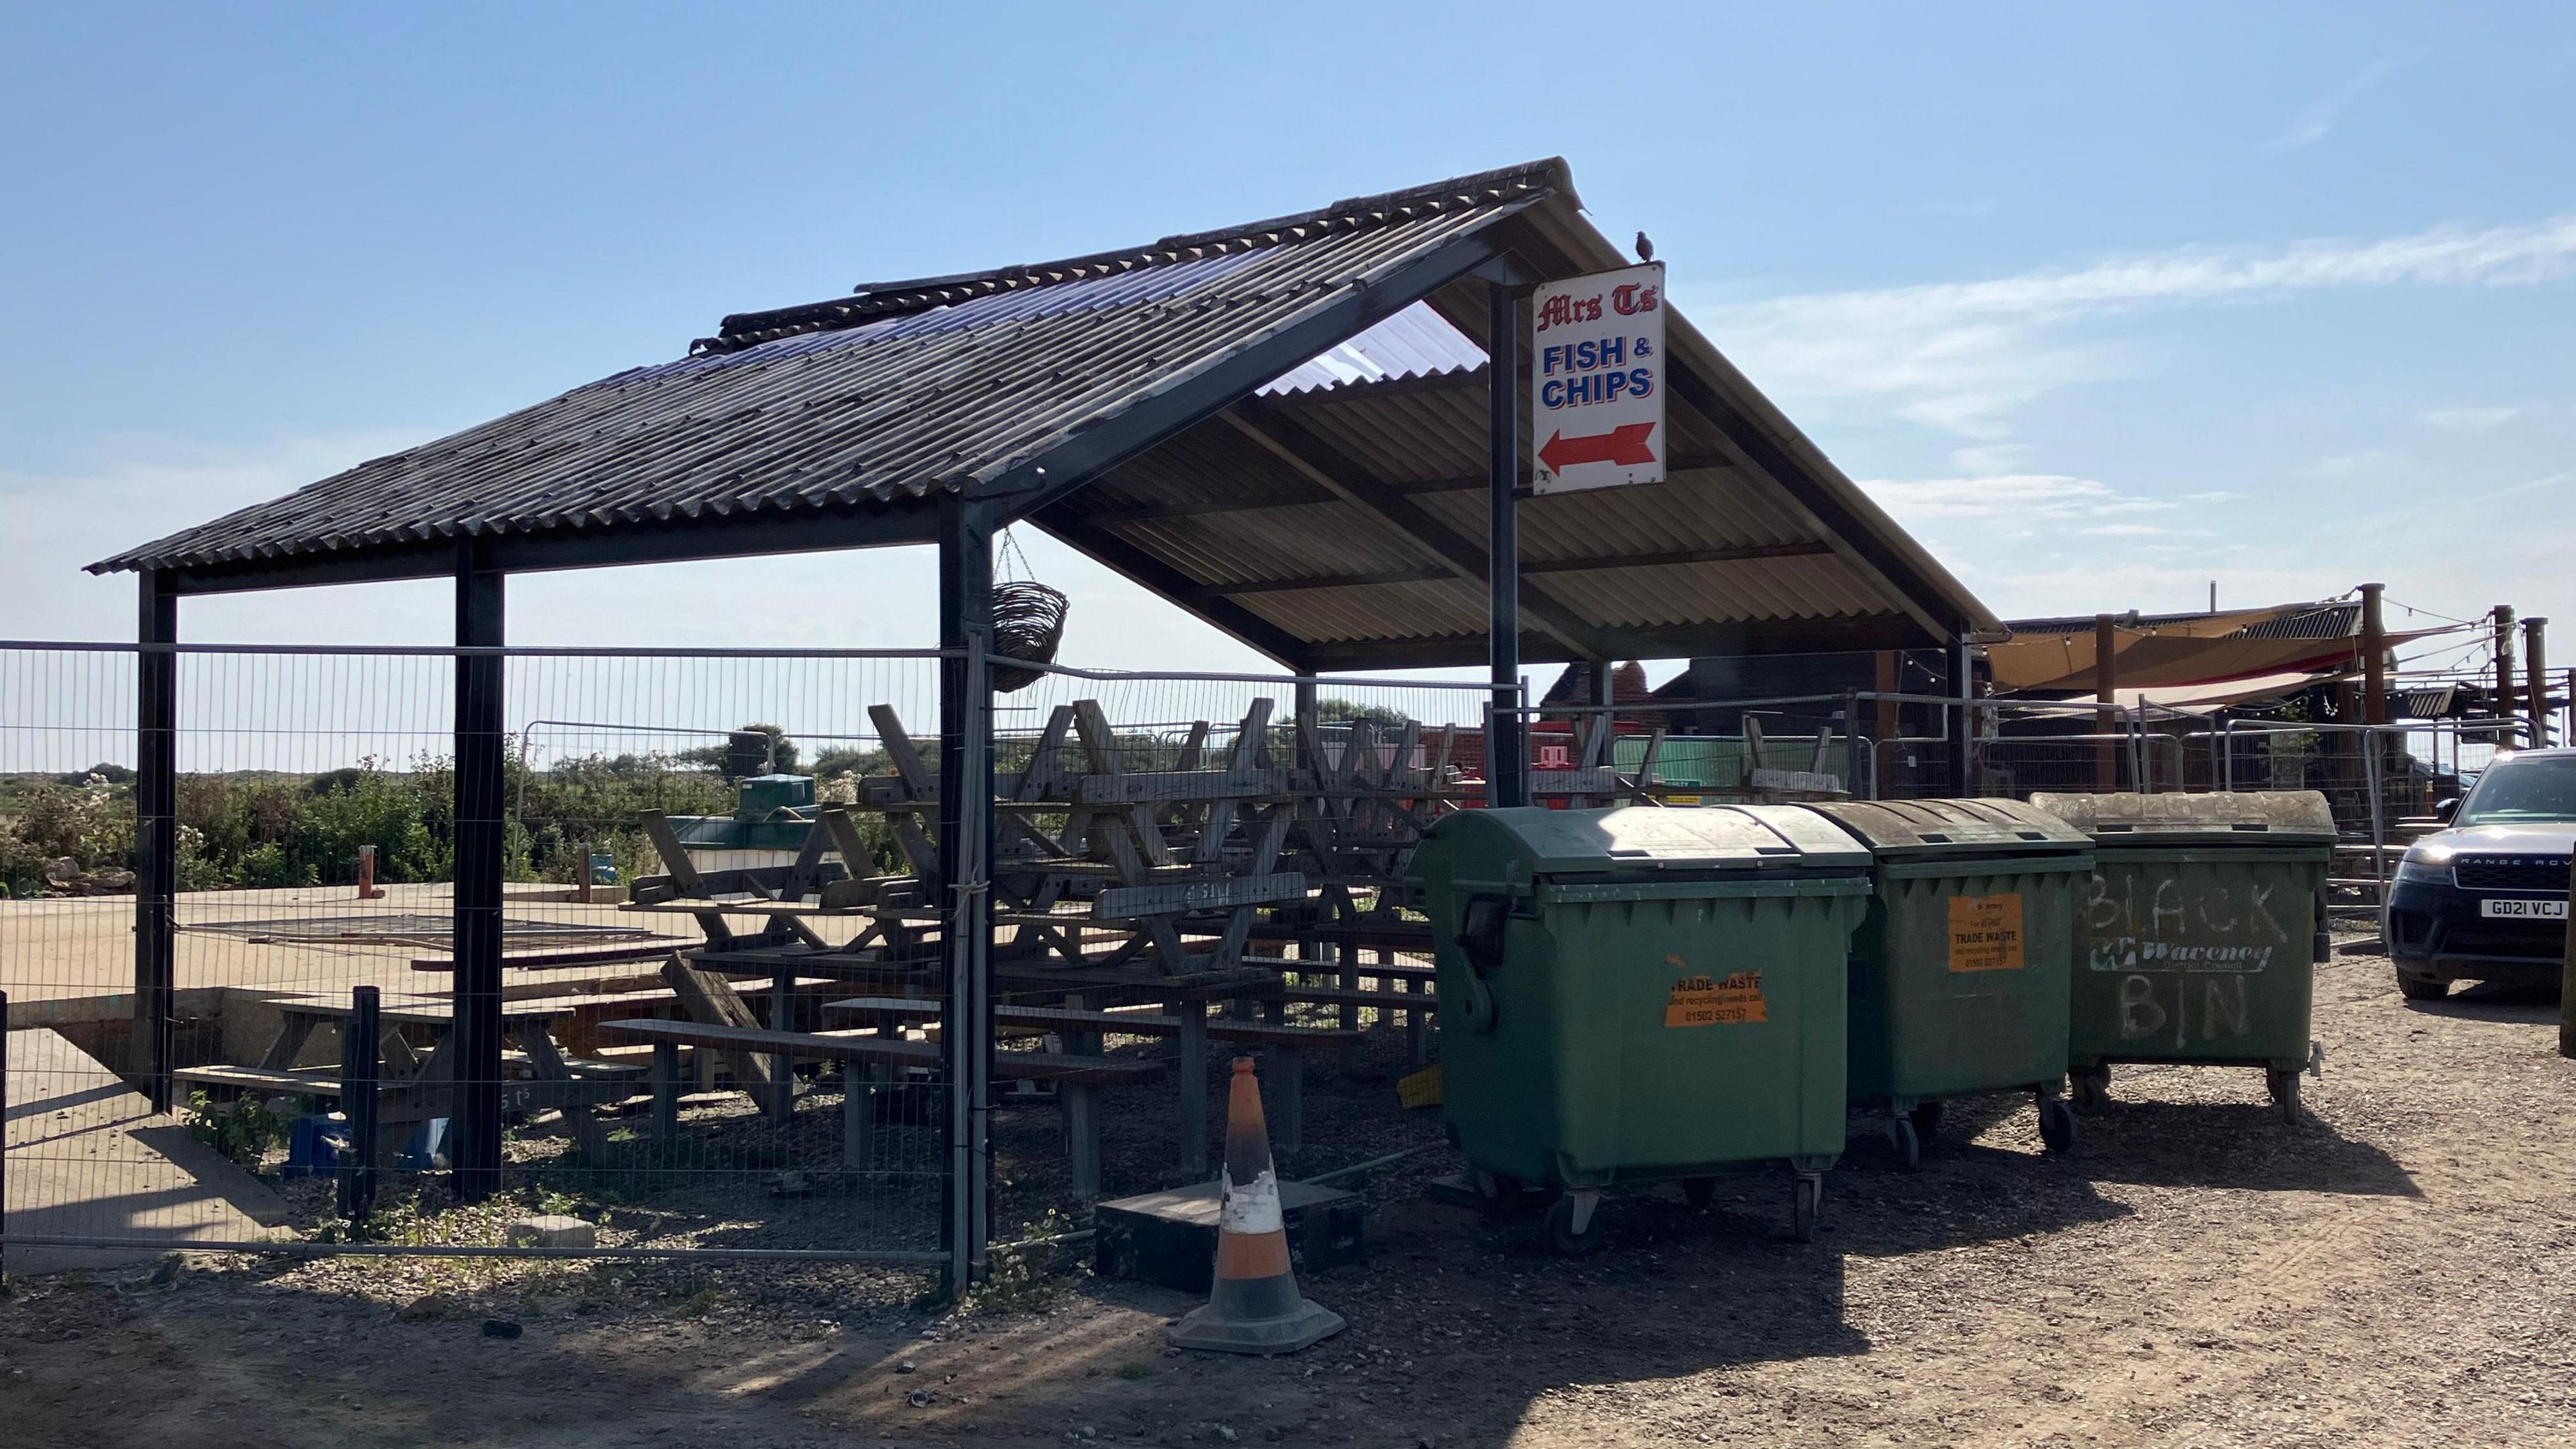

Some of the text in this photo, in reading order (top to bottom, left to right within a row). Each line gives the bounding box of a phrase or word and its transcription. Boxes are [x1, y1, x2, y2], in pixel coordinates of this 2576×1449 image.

[1537, 282, 1659, 332] Mrs Ts
[1544, 336, 1654, 376] FISH &
[1542, 368, 1653, 411] CHIPS
[2461, 858, 2572, 867] RANGE ROV
[2492, 902, 2563, 916] GD21 VCJ
[1955, 931, 2017, 944] TRADE WASTE
[2164, 961, 2242, 970] District Council
[1686, 995, 1723, 1006] recycling
[1686, 1008, 1747, 1021] 01502 527157
[2120, 975, 2247, 1049] BIN
